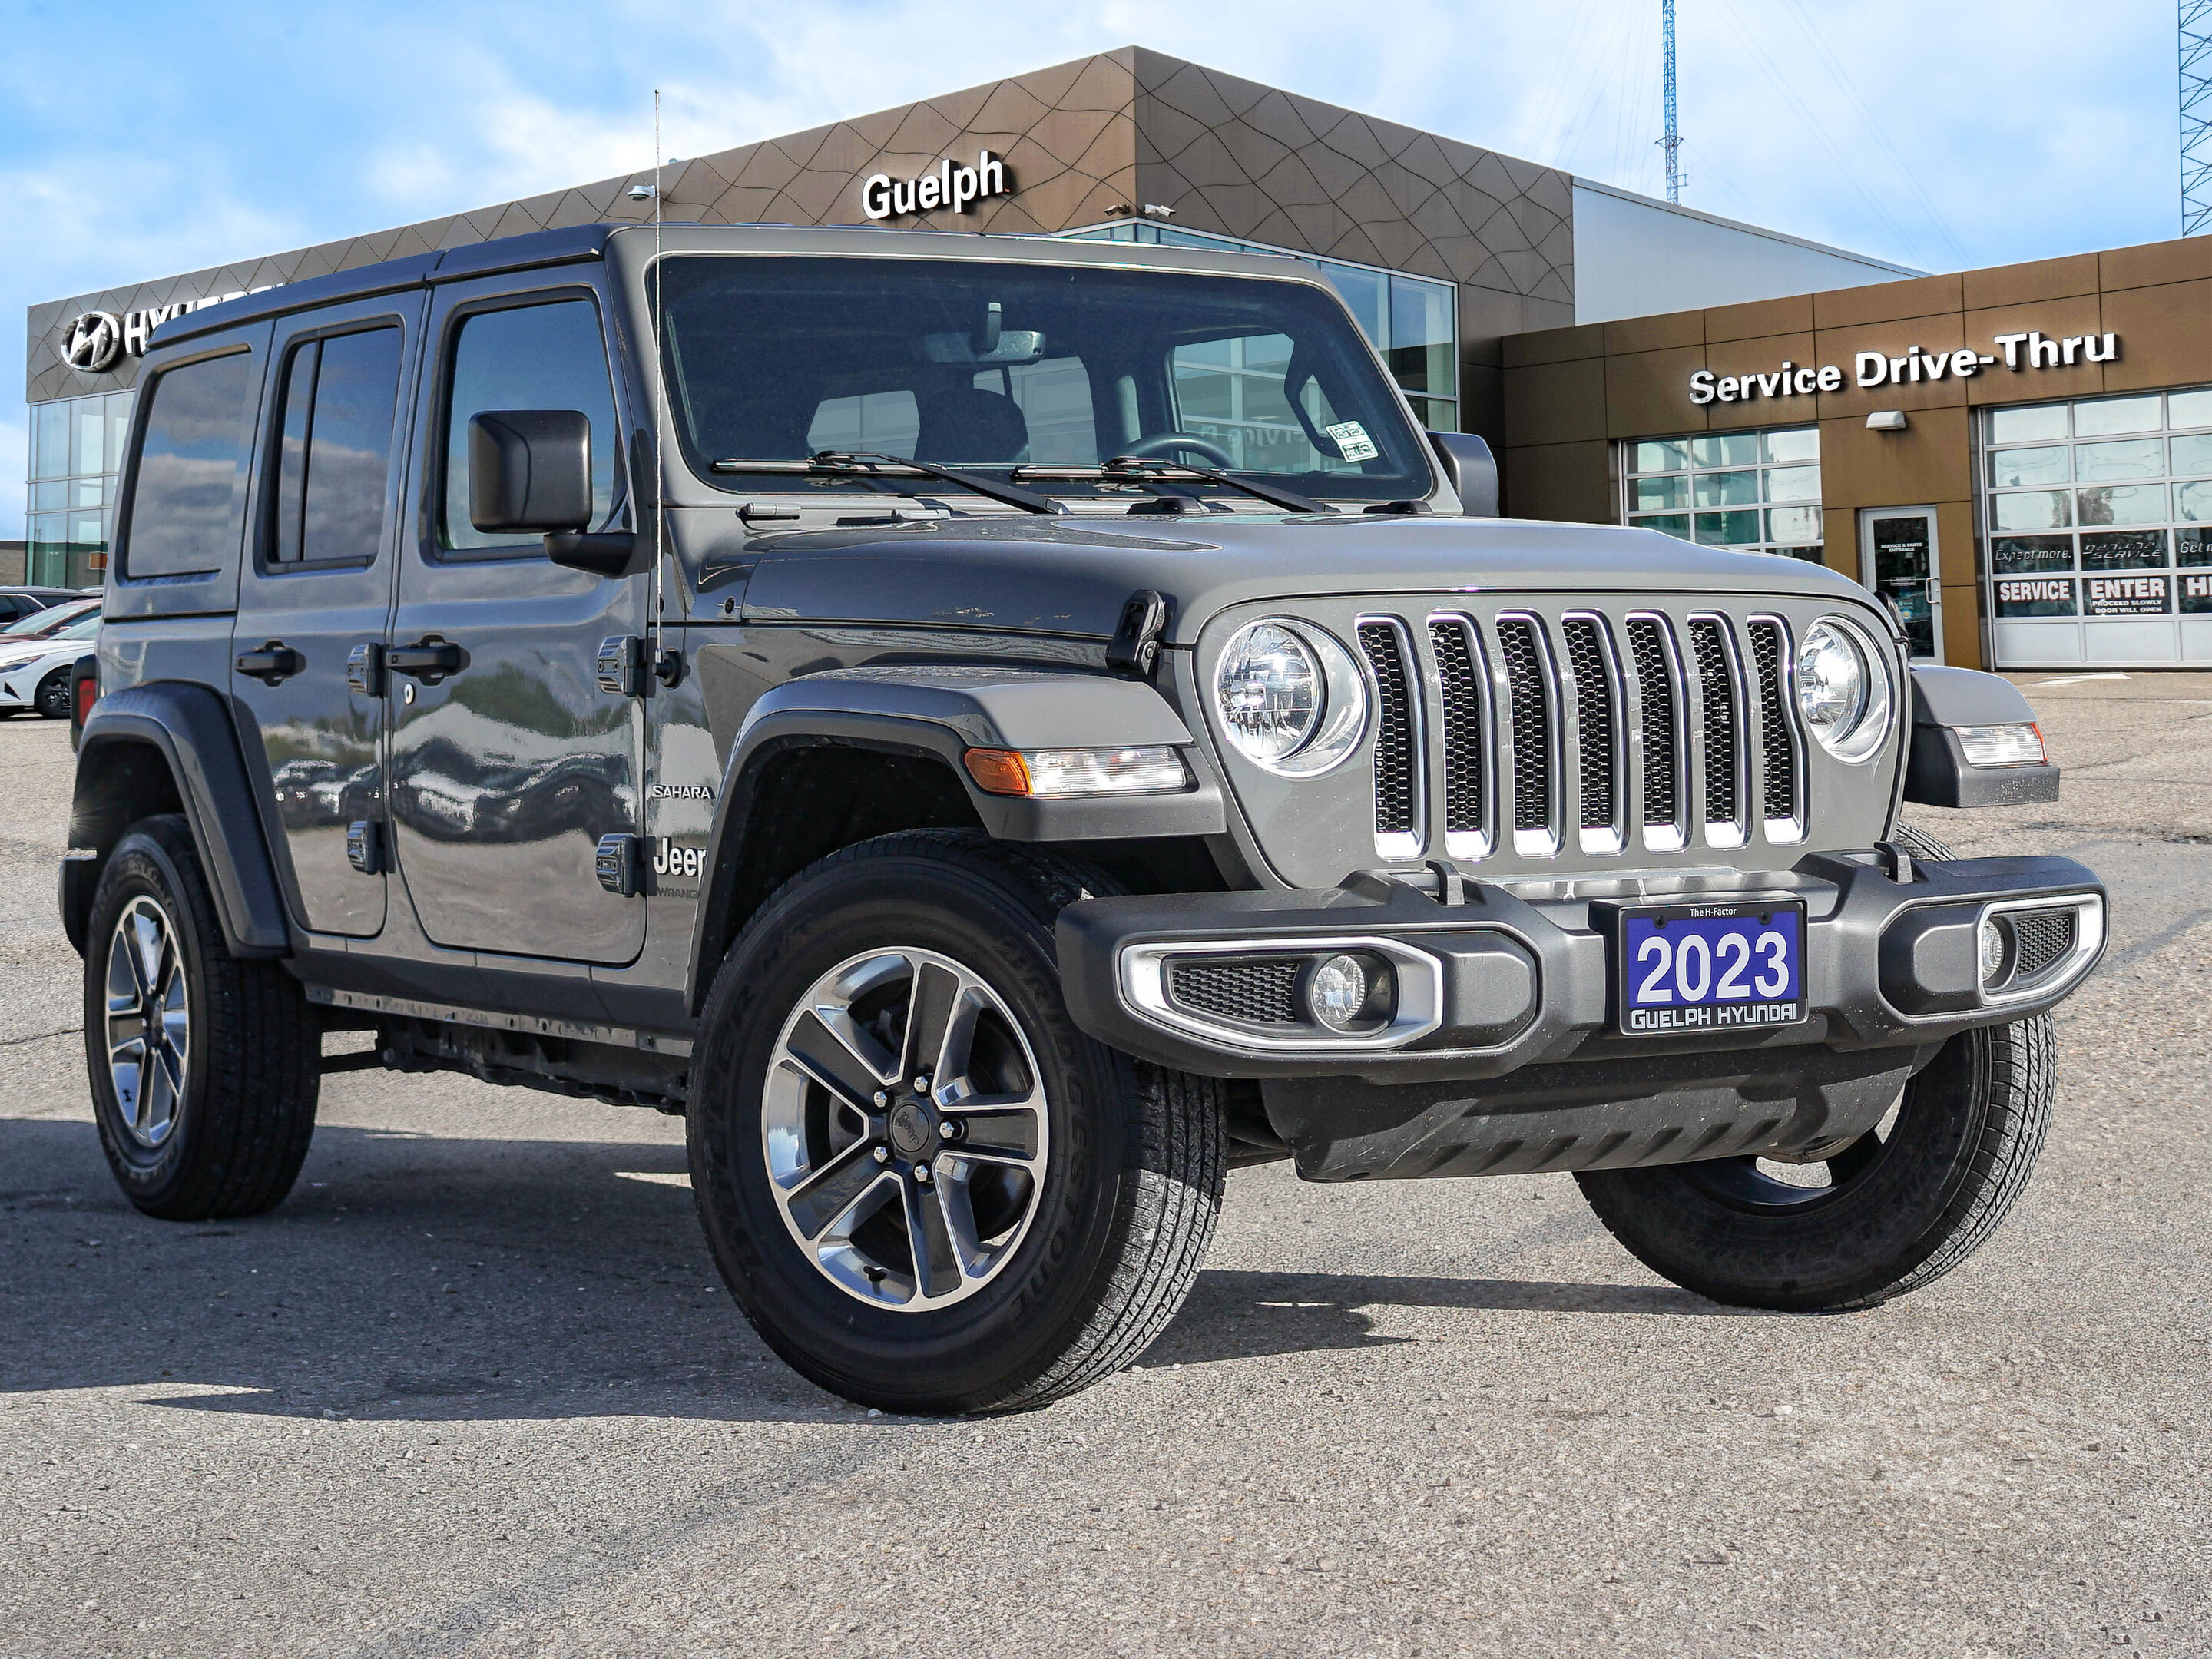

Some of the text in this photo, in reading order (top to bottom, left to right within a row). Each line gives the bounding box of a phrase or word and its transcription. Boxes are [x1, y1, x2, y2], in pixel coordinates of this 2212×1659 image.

[862, 149, 1005, 220] Guelph
[1688, 331, 2118, 404] Service Drive-Thru
[1995, 548, 2071, 563] Expect more.
[2082, 541, 2155, 555] genuine
[2091, 549, 2163, 560] SERVICE
[2180, 541, 2204, 553] Get
[1999, 581, 2071, 602] SERVICE
[2090, 578, 2166, 599] ENTER
[652, 785, 714, 799] SAHARA
[1689, 906, 1737, 918] The H-Factor
[1637, 931, 1790, 1004] 2023
[1631, 1002, 1797, 1029] GUELPH HYUNDAI
